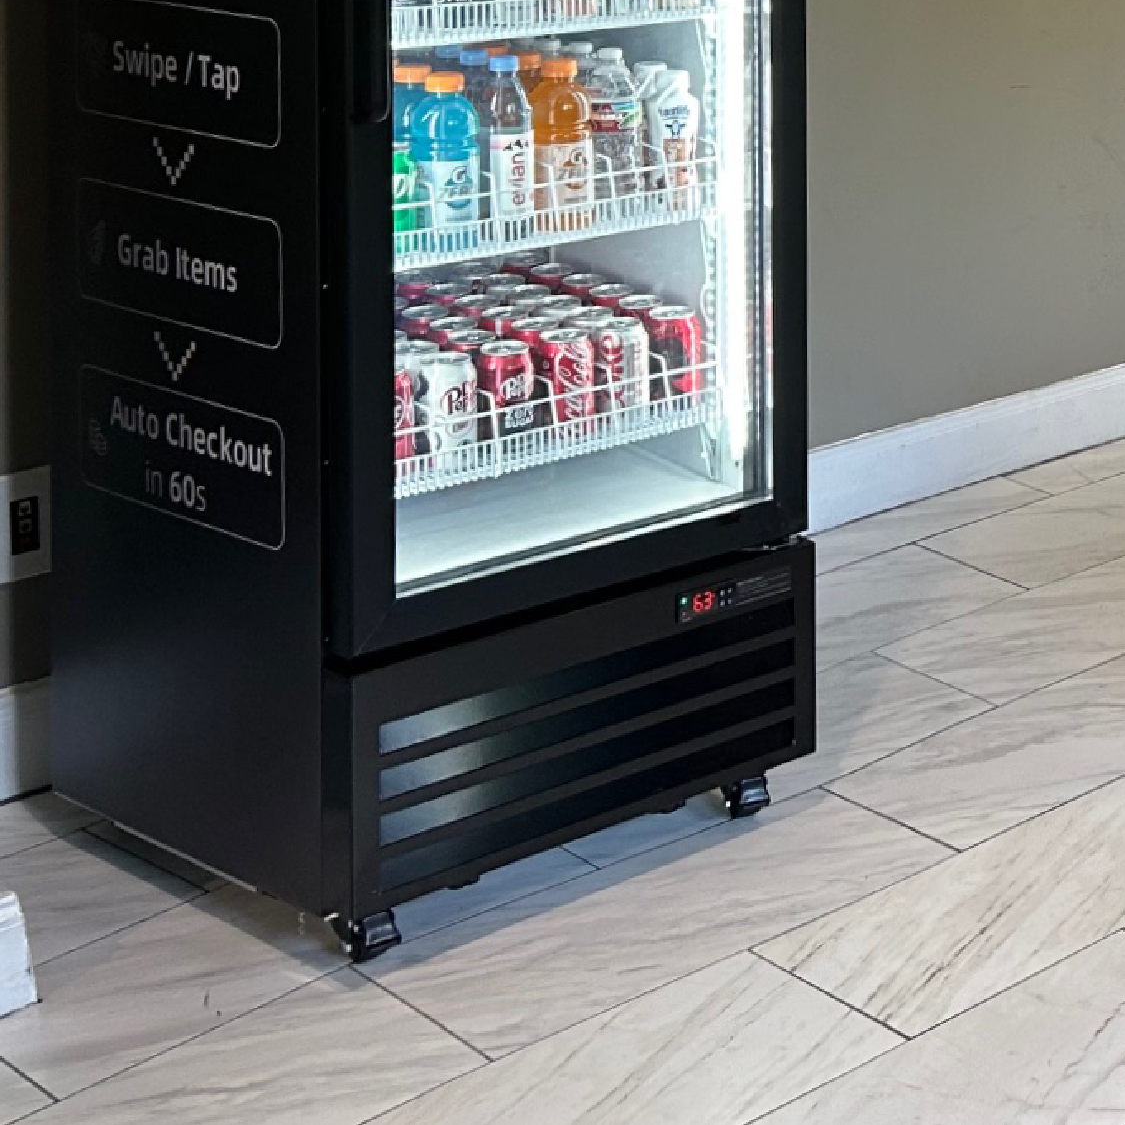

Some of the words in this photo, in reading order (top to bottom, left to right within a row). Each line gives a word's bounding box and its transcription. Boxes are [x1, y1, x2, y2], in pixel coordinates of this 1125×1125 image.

[112, 40, 177, 87] Swipe
[184, 50, 195, 85] /
[197, 54, 240, 100] Tap
[117, 233, 169, 275] Grab
[175, 246, 238, 293] Items
[110, 395, 159, 440] Auto
[166, 412, 273, 477] Checkout
[145, 460, 163, 497] in
[169, 471, 206, 511] 60s
[693, 591, 715, 612] 63
